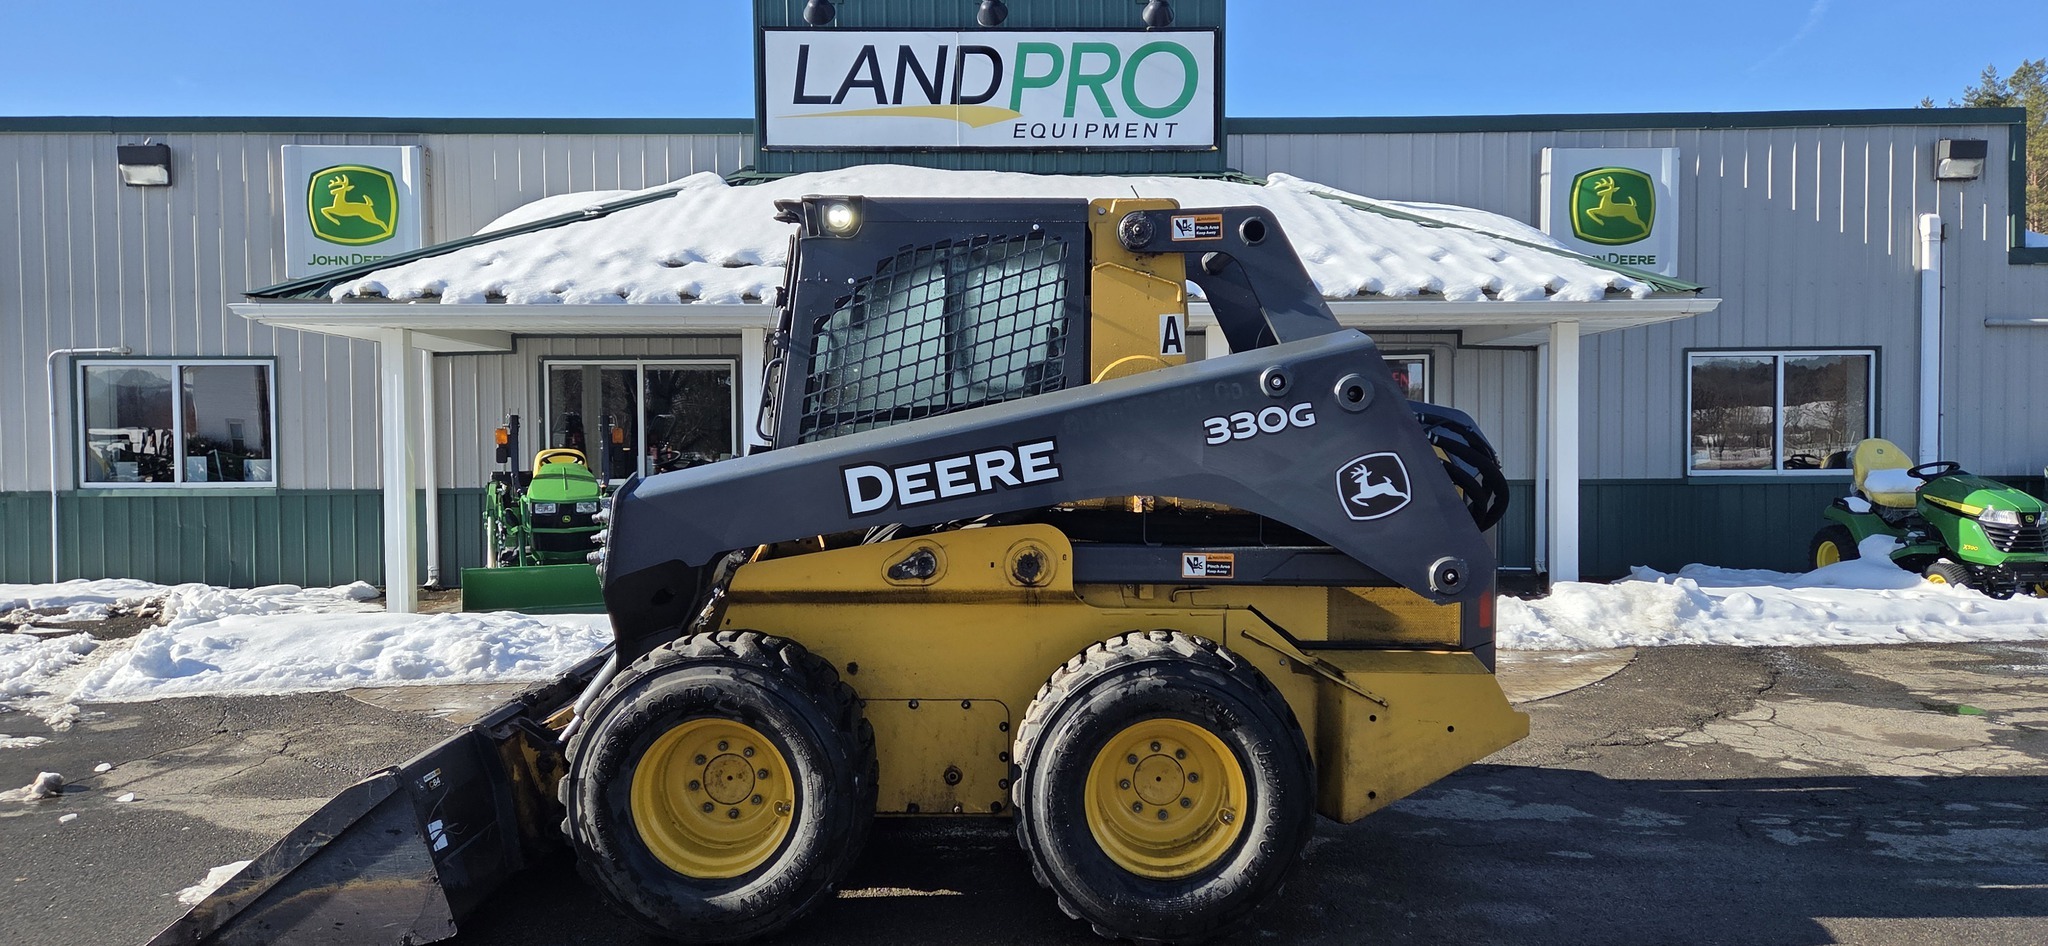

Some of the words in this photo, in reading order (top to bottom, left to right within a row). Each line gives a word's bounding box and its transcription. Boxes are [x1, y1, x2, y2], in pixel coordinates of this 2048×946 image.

[1012, 123, 1179, 139] EQUIPMENT
[307, 253, 348, 266] JOHN
[1608, 252, 1656, 265] DEERE
[1161, 315, 1183, 354] A
[1203, 402, 1316, 446] 330G
[843, 440, 1060, 515] DEERE
